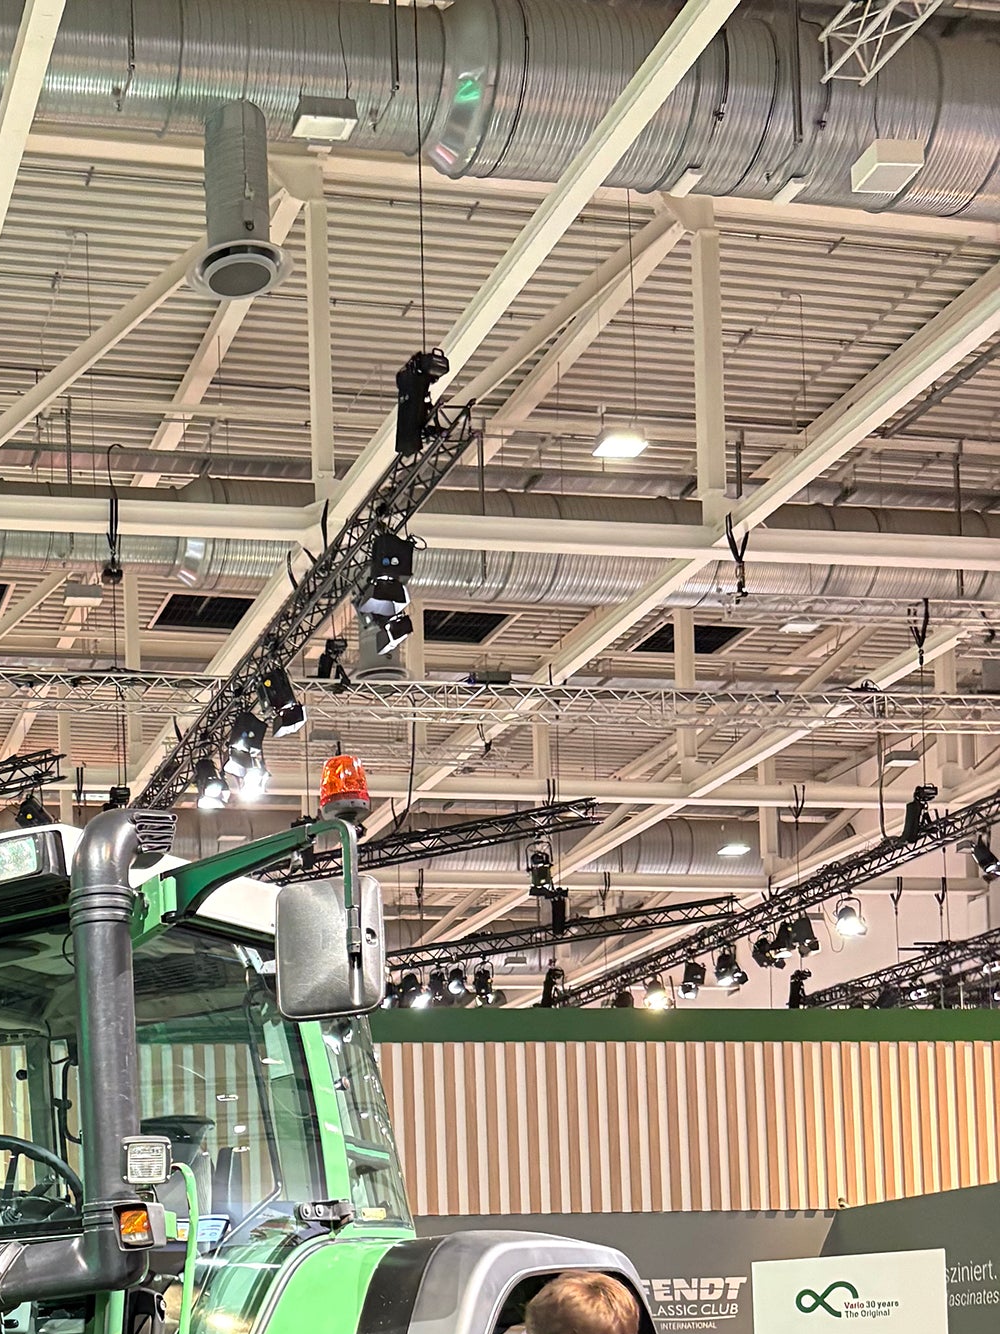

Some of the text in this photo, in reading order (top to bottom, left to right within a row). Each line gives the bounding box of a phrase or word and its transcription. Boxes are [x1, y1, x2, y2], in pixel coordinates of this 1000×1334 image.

[866, 1301, 876, 1309] 30
[877, 1300, 899, 1309] years
[652, 1303, 739, 1316] ASSIC CLUB
[844, 1309, 890, 1319] The Original
[660, 1321, 718, 1330] INTERNATIONAL
